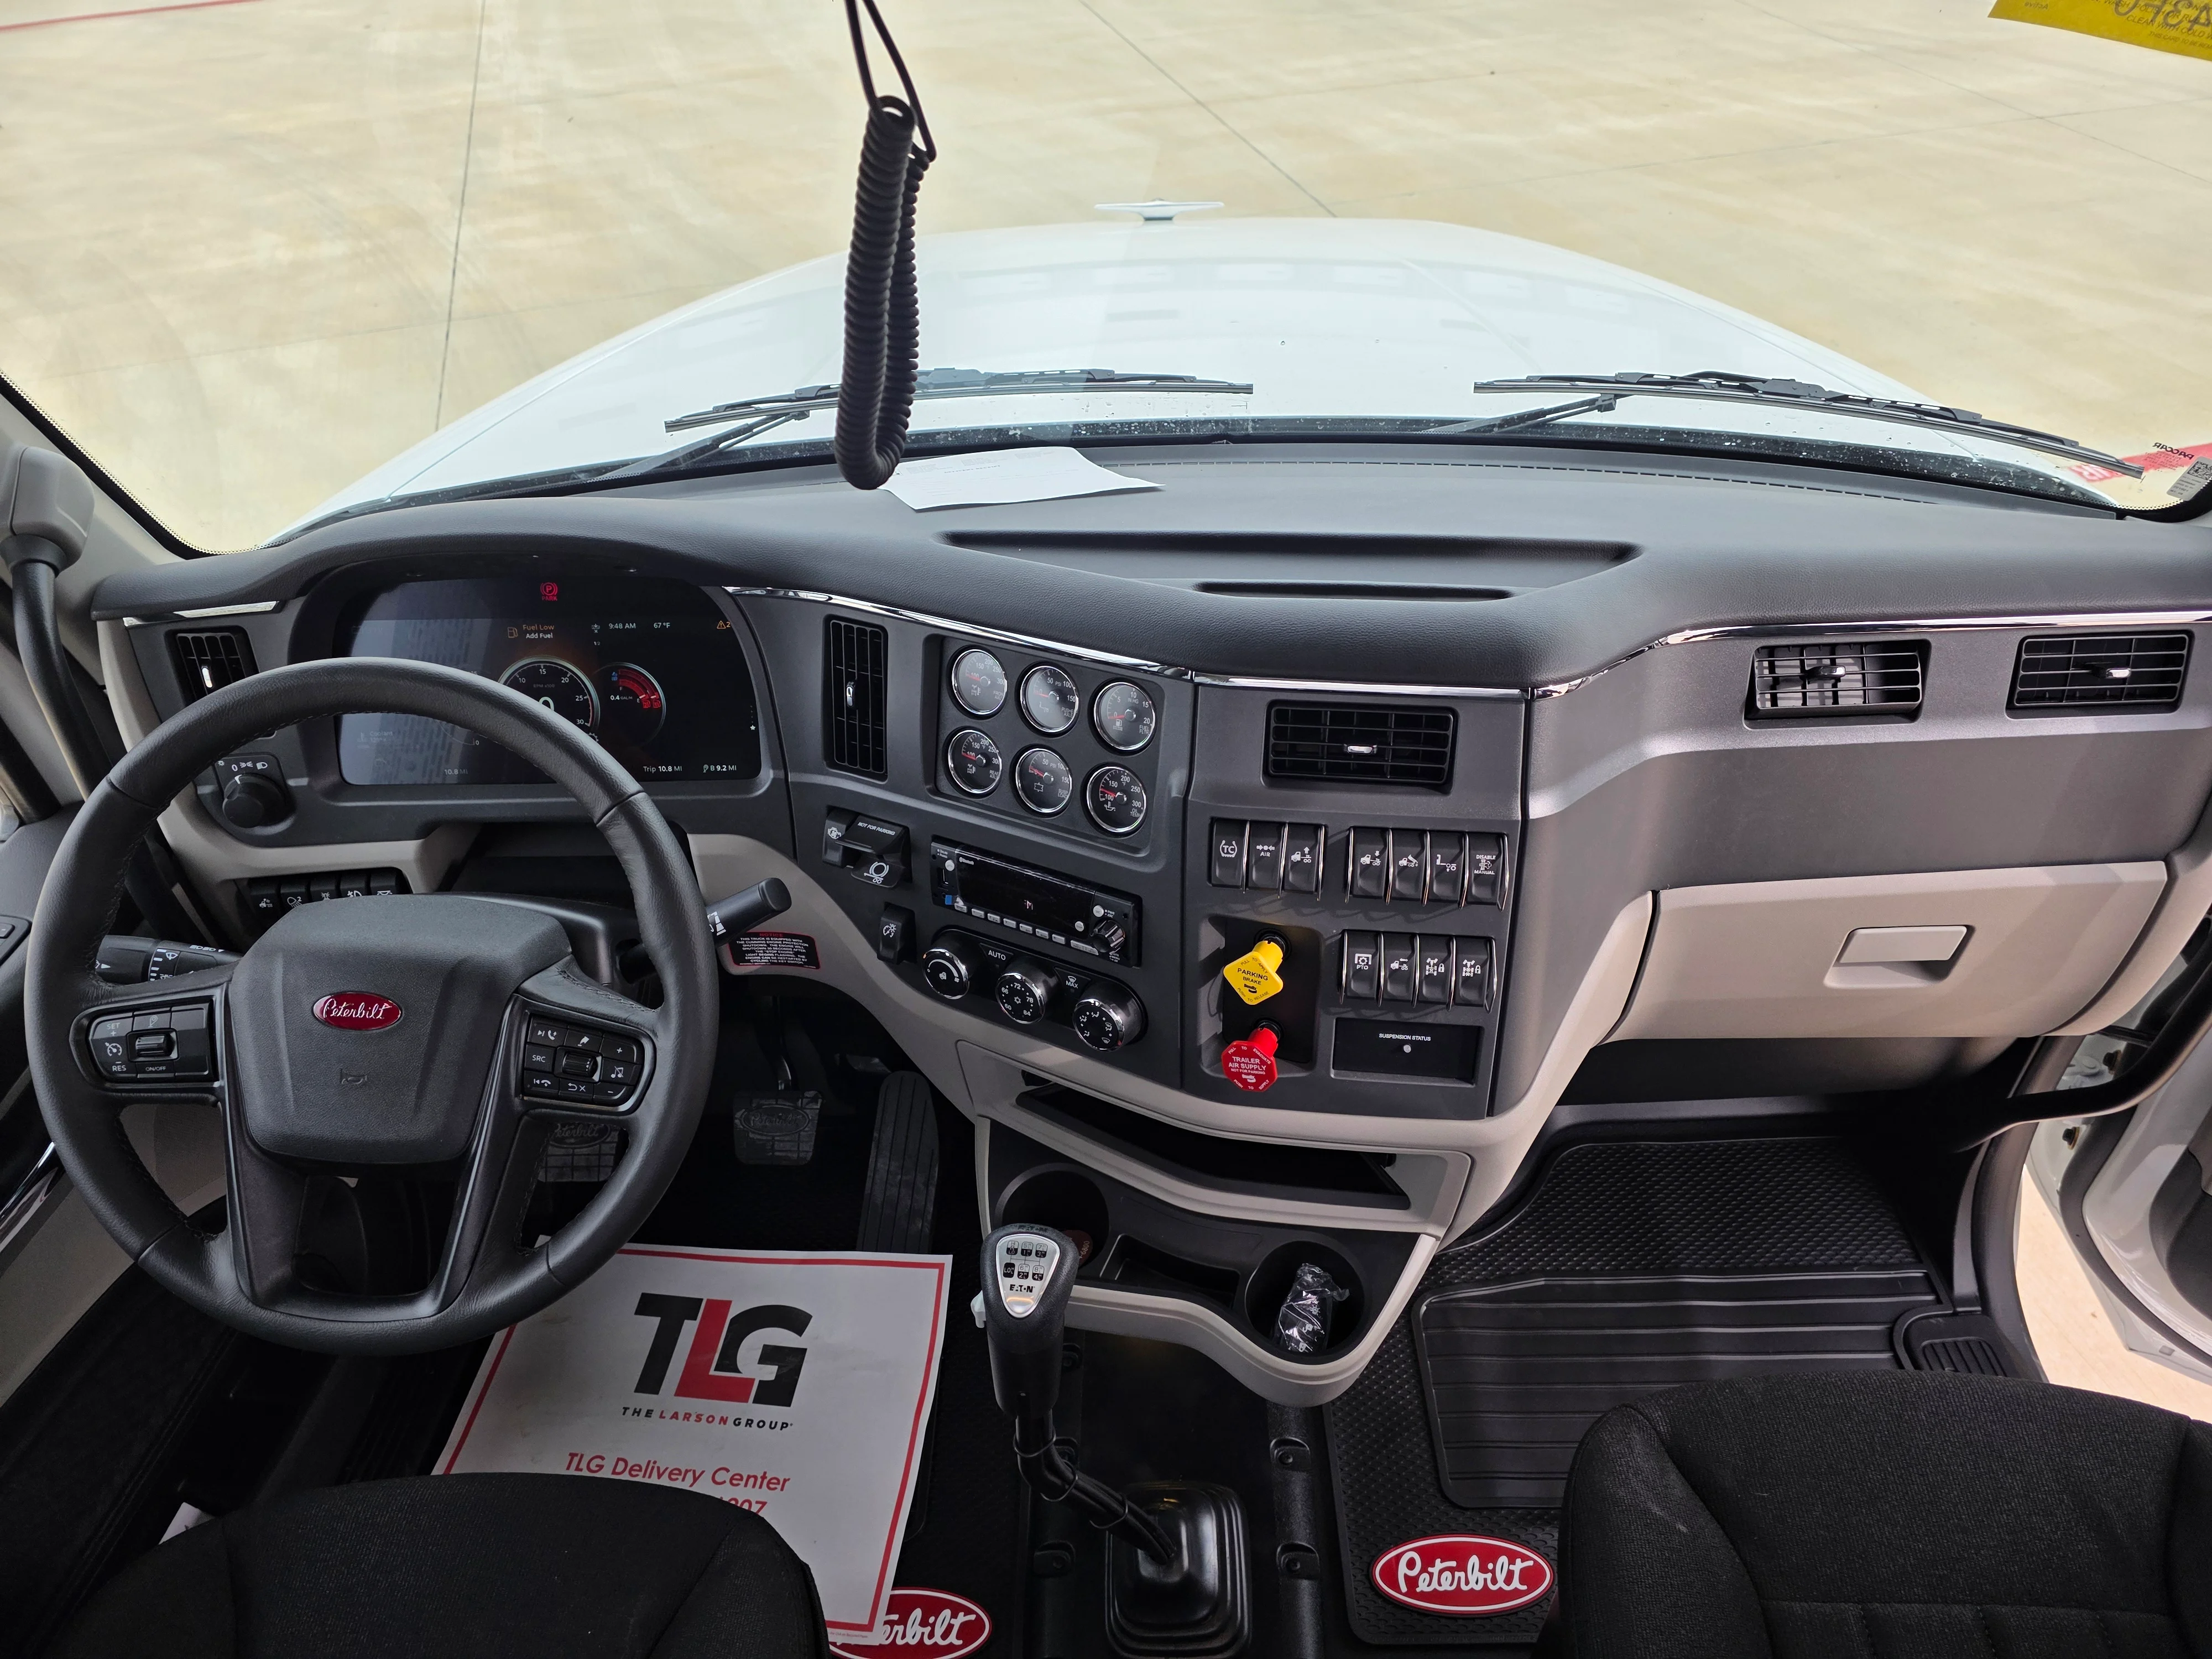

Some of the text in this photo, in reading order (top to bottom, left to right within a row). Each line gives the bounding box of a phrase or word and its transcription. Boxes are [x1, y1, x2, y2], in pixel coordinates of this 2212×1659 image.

[2127, 15, 2155, 27] CLEAN
[2181, 27, 2205, 38] COLD
[876, 827, 896, 836] PARKING
[1223, 846, 1234, 854] TC
[988, 950, 1006, 961] AUTO
[1238, 968, 1268, 980] PARKING
[1258, 963, 1268, 974] APPLY
[1066, 980, 1078, 989] MAX
[1243, 977, 1261, 985] BRAKE
[1238, 988, 1246, 997] PUSH
[1254, 991, 1269, 1001] RELEASE
[323, 999, 393, 1019] Peterbilt
[1253, 1048, 1271, 1065] EVACUATE
[555, 1123, 600, 1138] Peterbilt
[634, 1292, 812, 1407] TLG
[622, 1407, 789, 1431] THE LARSON GROUP
[566, 1452, 790, 1491] TLG Delivery Center
[1398, 1551, 1533, 1593] Peterbilt
